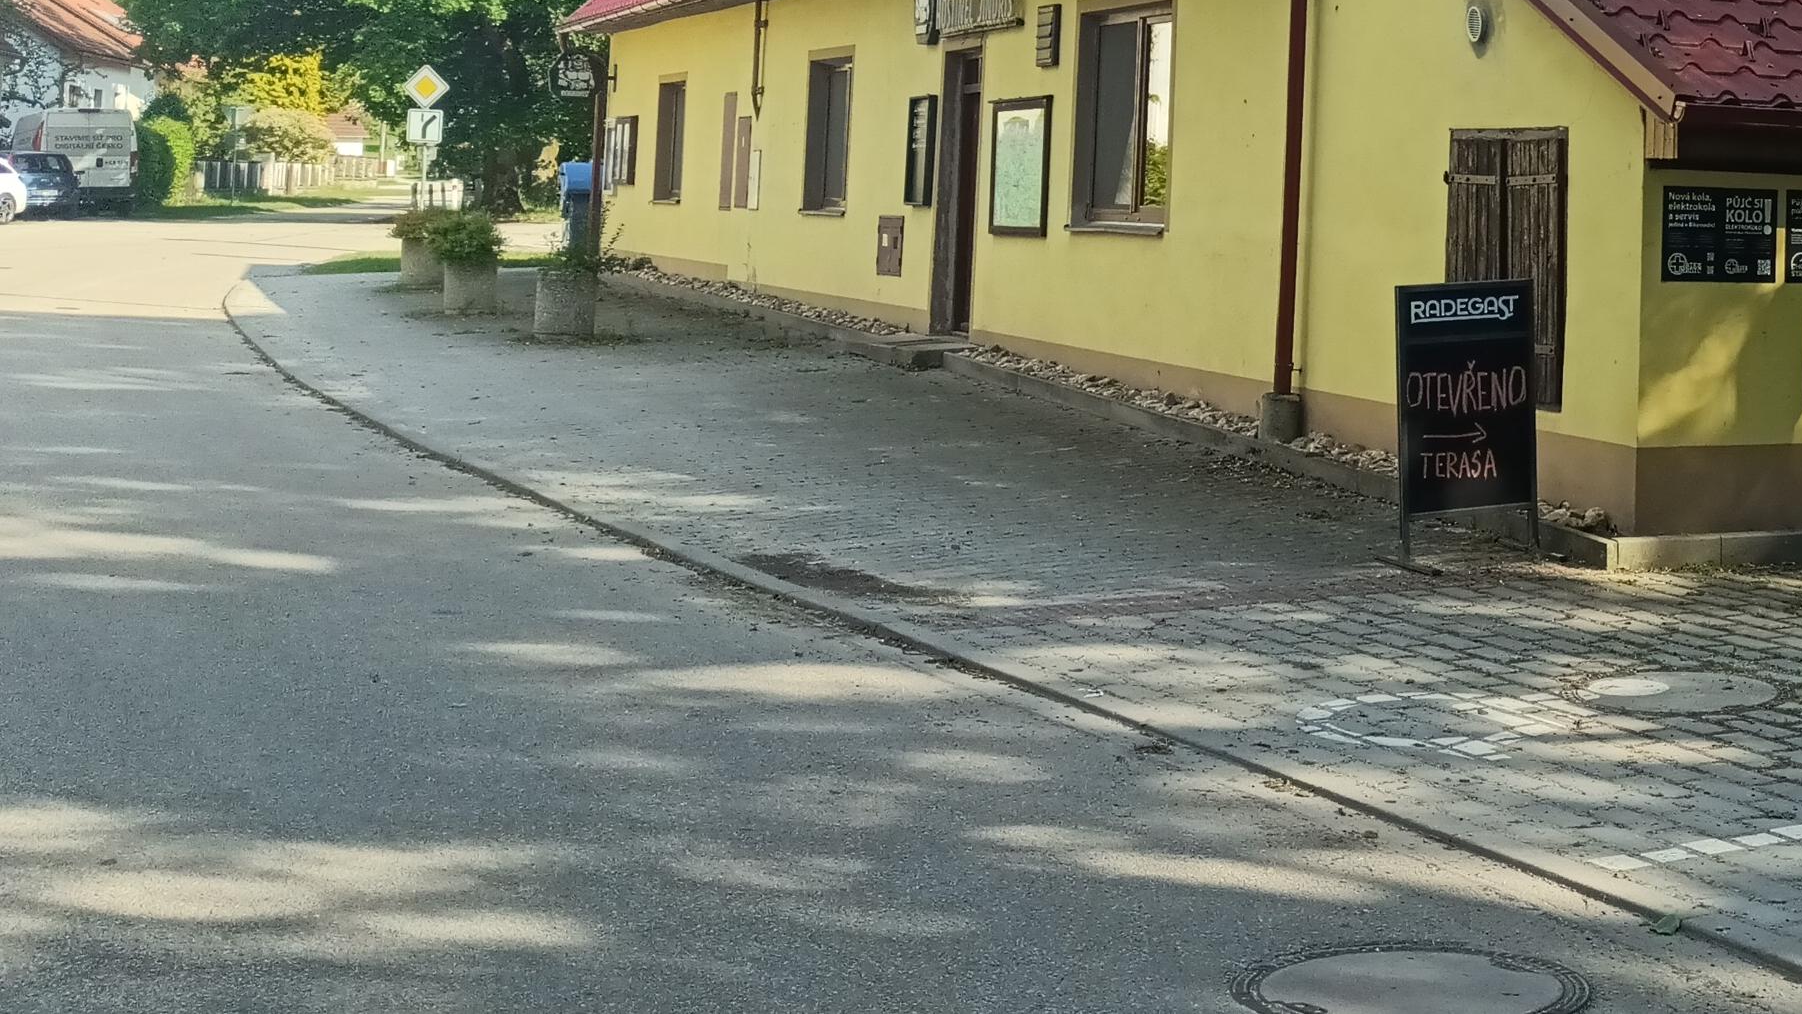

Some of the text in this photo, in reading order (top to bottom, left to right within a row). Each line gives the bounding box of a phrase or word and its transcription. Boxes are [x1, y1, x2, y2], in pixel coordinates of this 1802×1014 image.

[1410, 295, 1519, 324] RADEGAST
[1406, 359, 1527, 417] OTEVŘENO
[1420, 448, 1498, 480] TERASA
